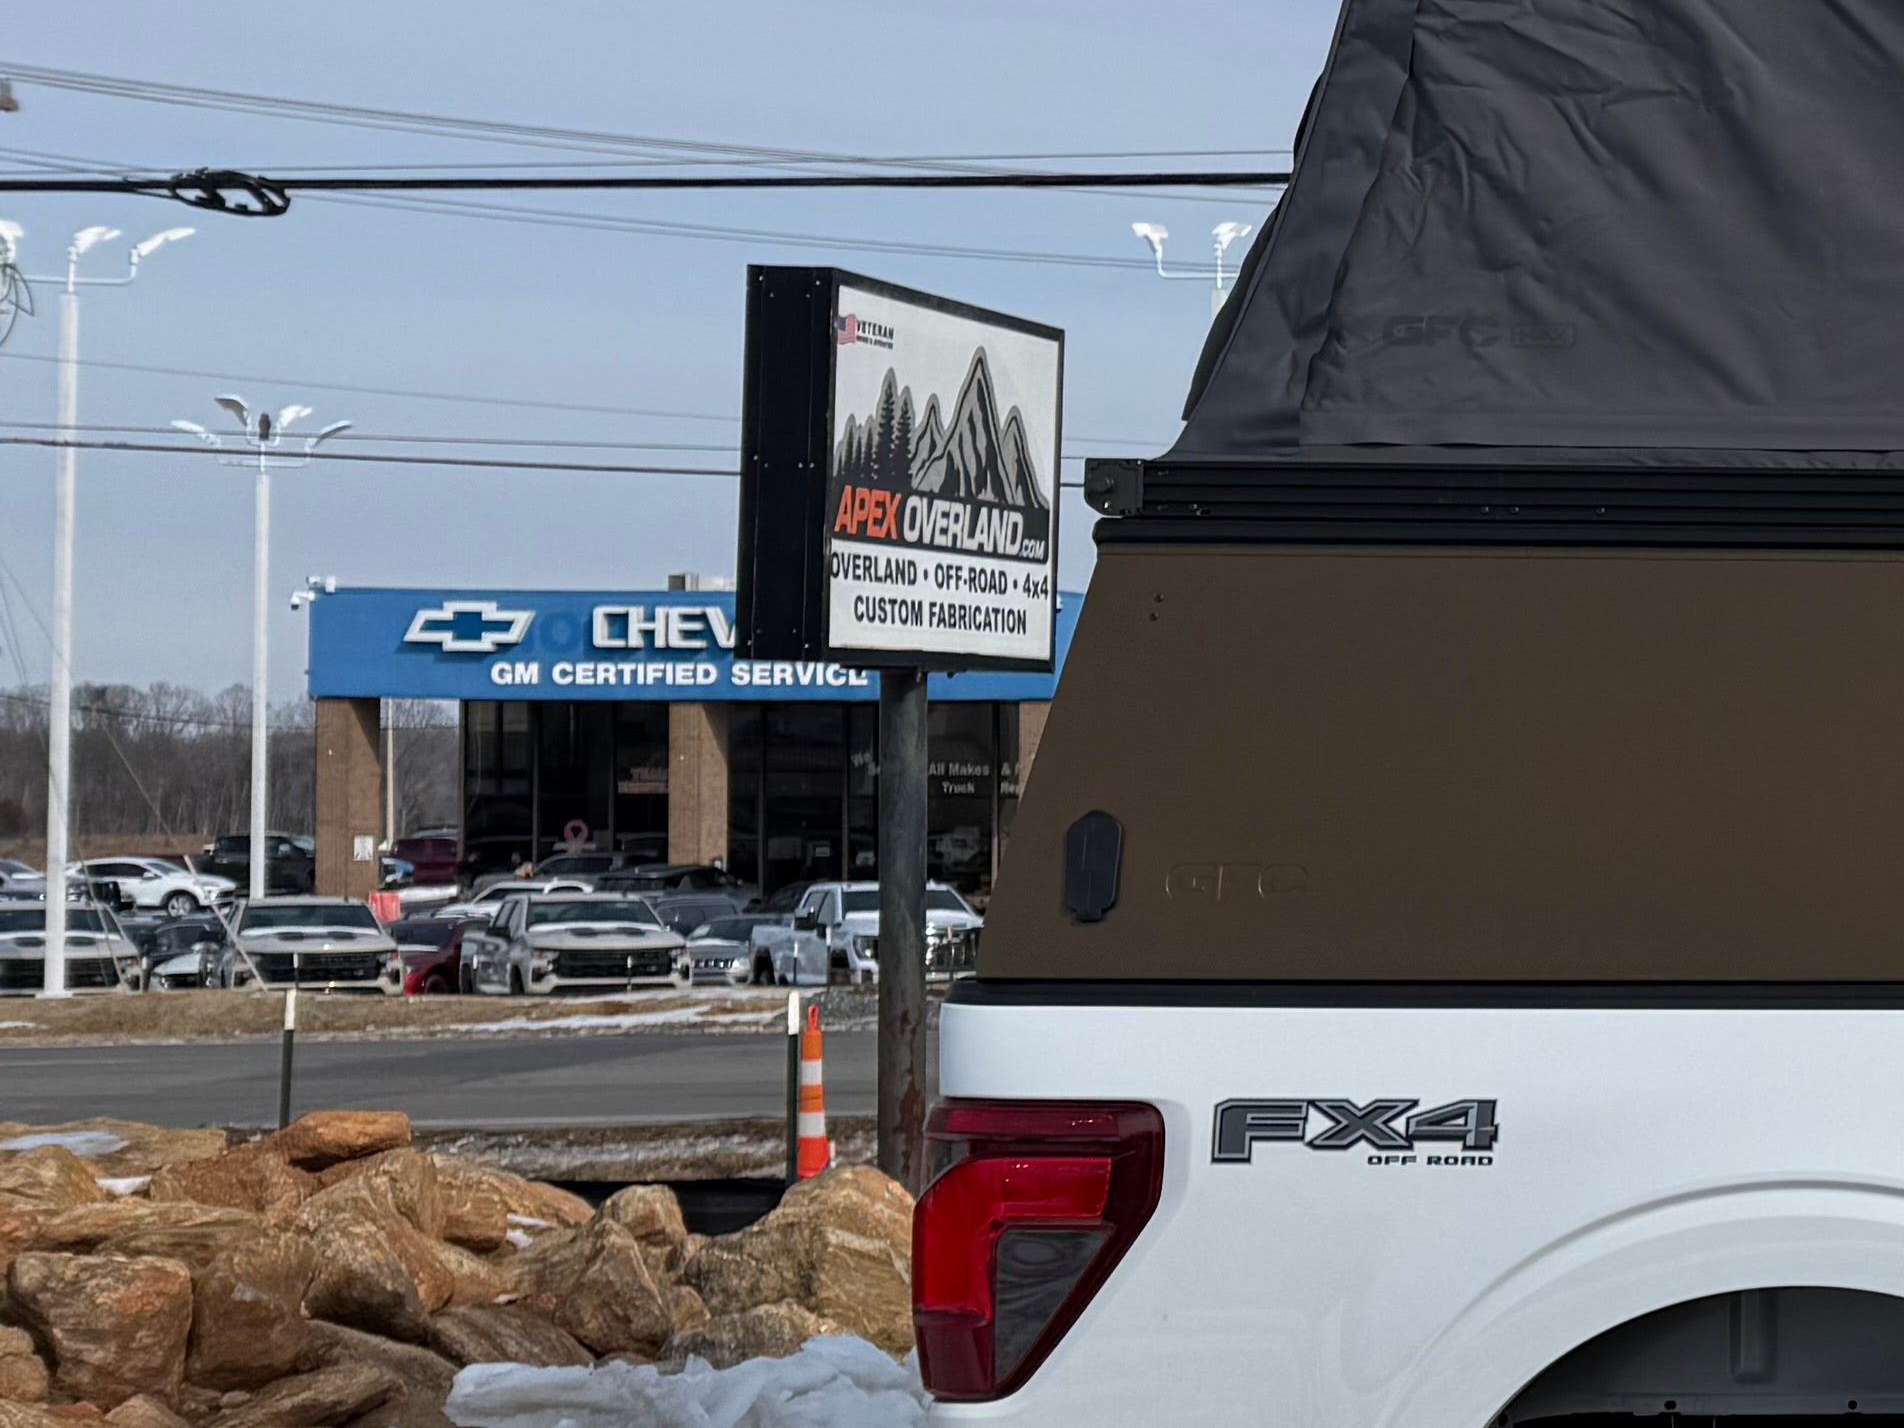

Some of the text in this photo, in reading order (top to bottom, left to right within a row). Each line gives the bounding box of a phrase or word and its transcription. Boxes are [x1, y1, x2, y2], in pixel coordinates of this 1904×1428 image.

[834, 485, 902, 540] APEX
[831, 551, 1049, 601] OVERLAND OFF-ROAD 4x4
[854, 595, 1027, 635] CUSTOM FABRICATION
[491, 661, 539, 686] GM
[552, 661, 718, 686] CERTIFIED
[1210, 1098, 1500, 1164] FX4
[1367, 1154, 1494, 1166] OFF ROAD
